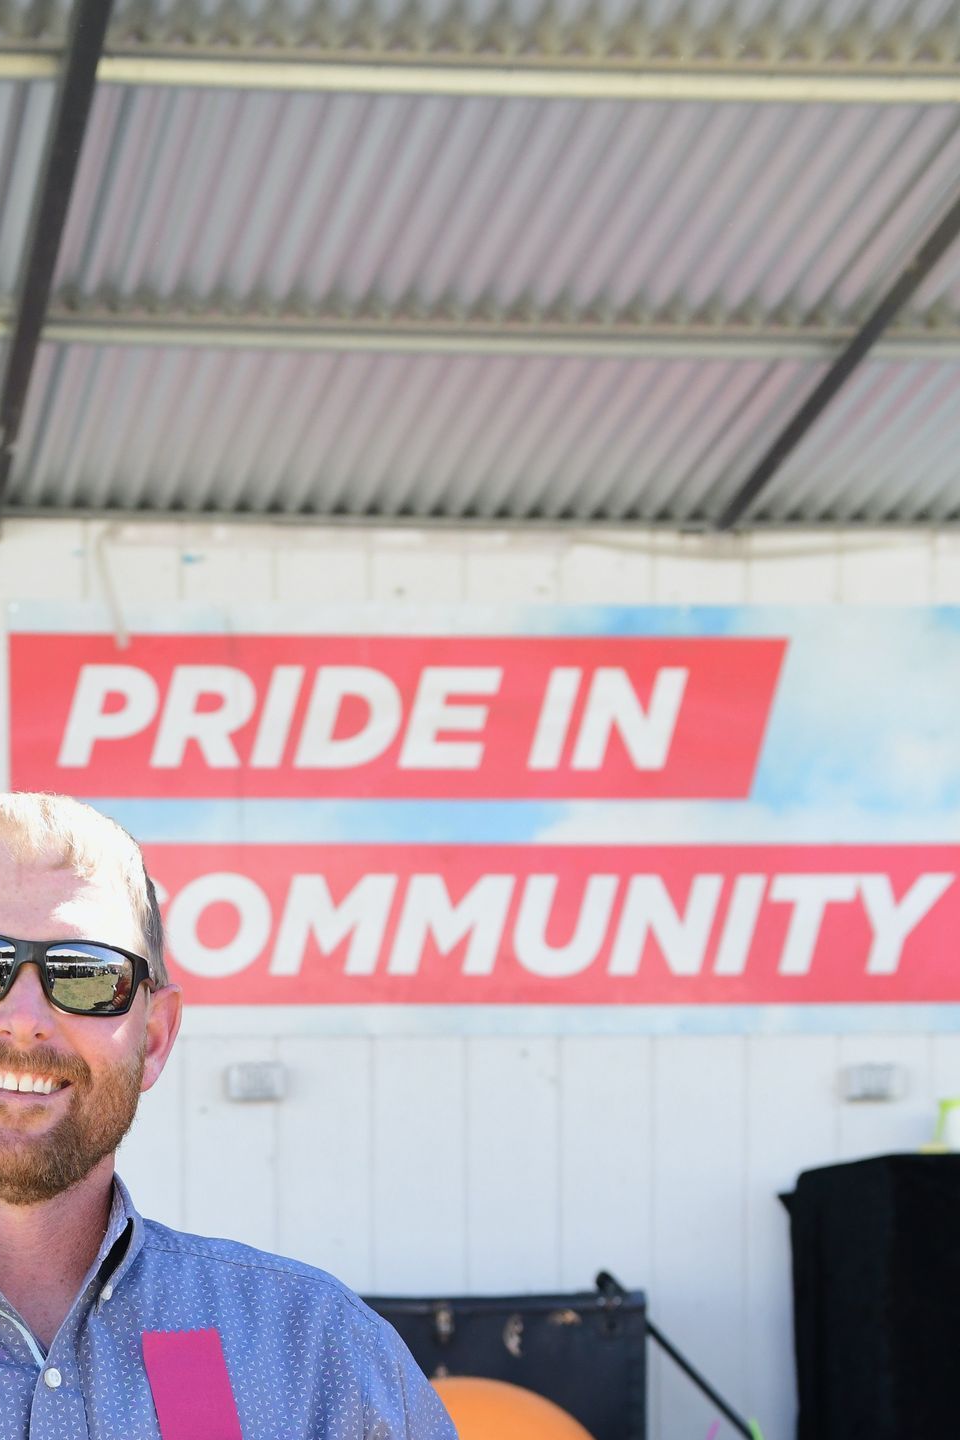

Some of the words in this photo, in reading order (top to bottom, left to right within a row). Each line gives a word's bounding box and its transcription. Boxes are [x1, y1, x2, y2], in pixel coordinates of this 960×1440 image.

[57, 664, 502, 770] PRIDE
[528, 666, 689, 771] IN
[152, 872, 954, 979] OMMUNITY
